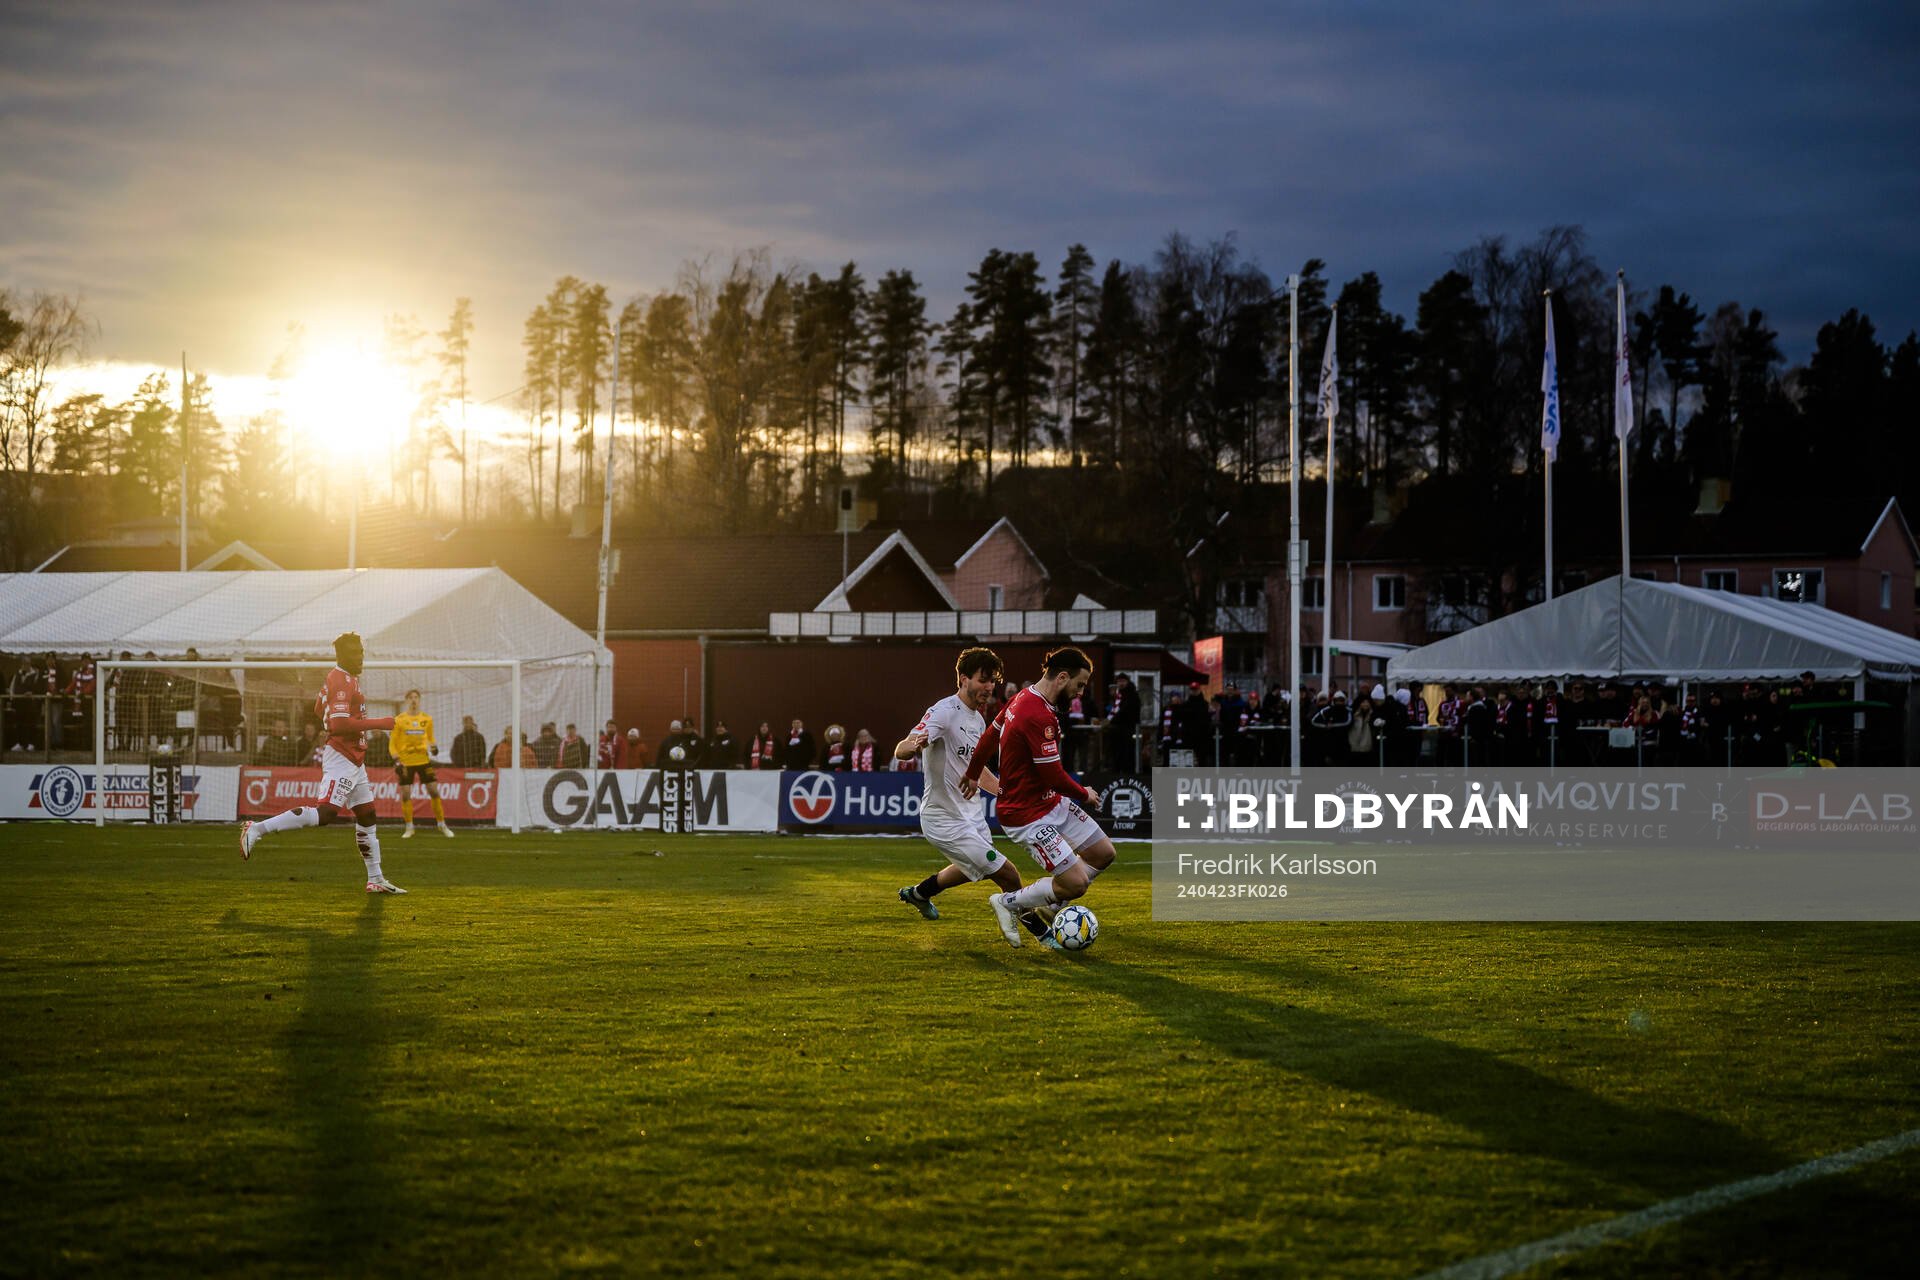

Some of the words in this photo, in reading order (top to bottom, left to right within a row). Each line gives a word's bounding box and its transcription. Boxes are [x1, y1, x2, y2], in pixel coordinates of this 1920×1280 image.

[153, 766, 168, 824] SELECT
[662, 770, 679, 833] SELECT
[684, 770, 694, 833] SELECT
[1756, 792, 1913, 821] D-LAB
[1035, 825, 1054, 840] CEO
[1756, 821, 1816, 832] DEGERFORS
[1820, 822, 1899, 833] LABORATORIUM
[1903, 823, 1917, 833] AB
